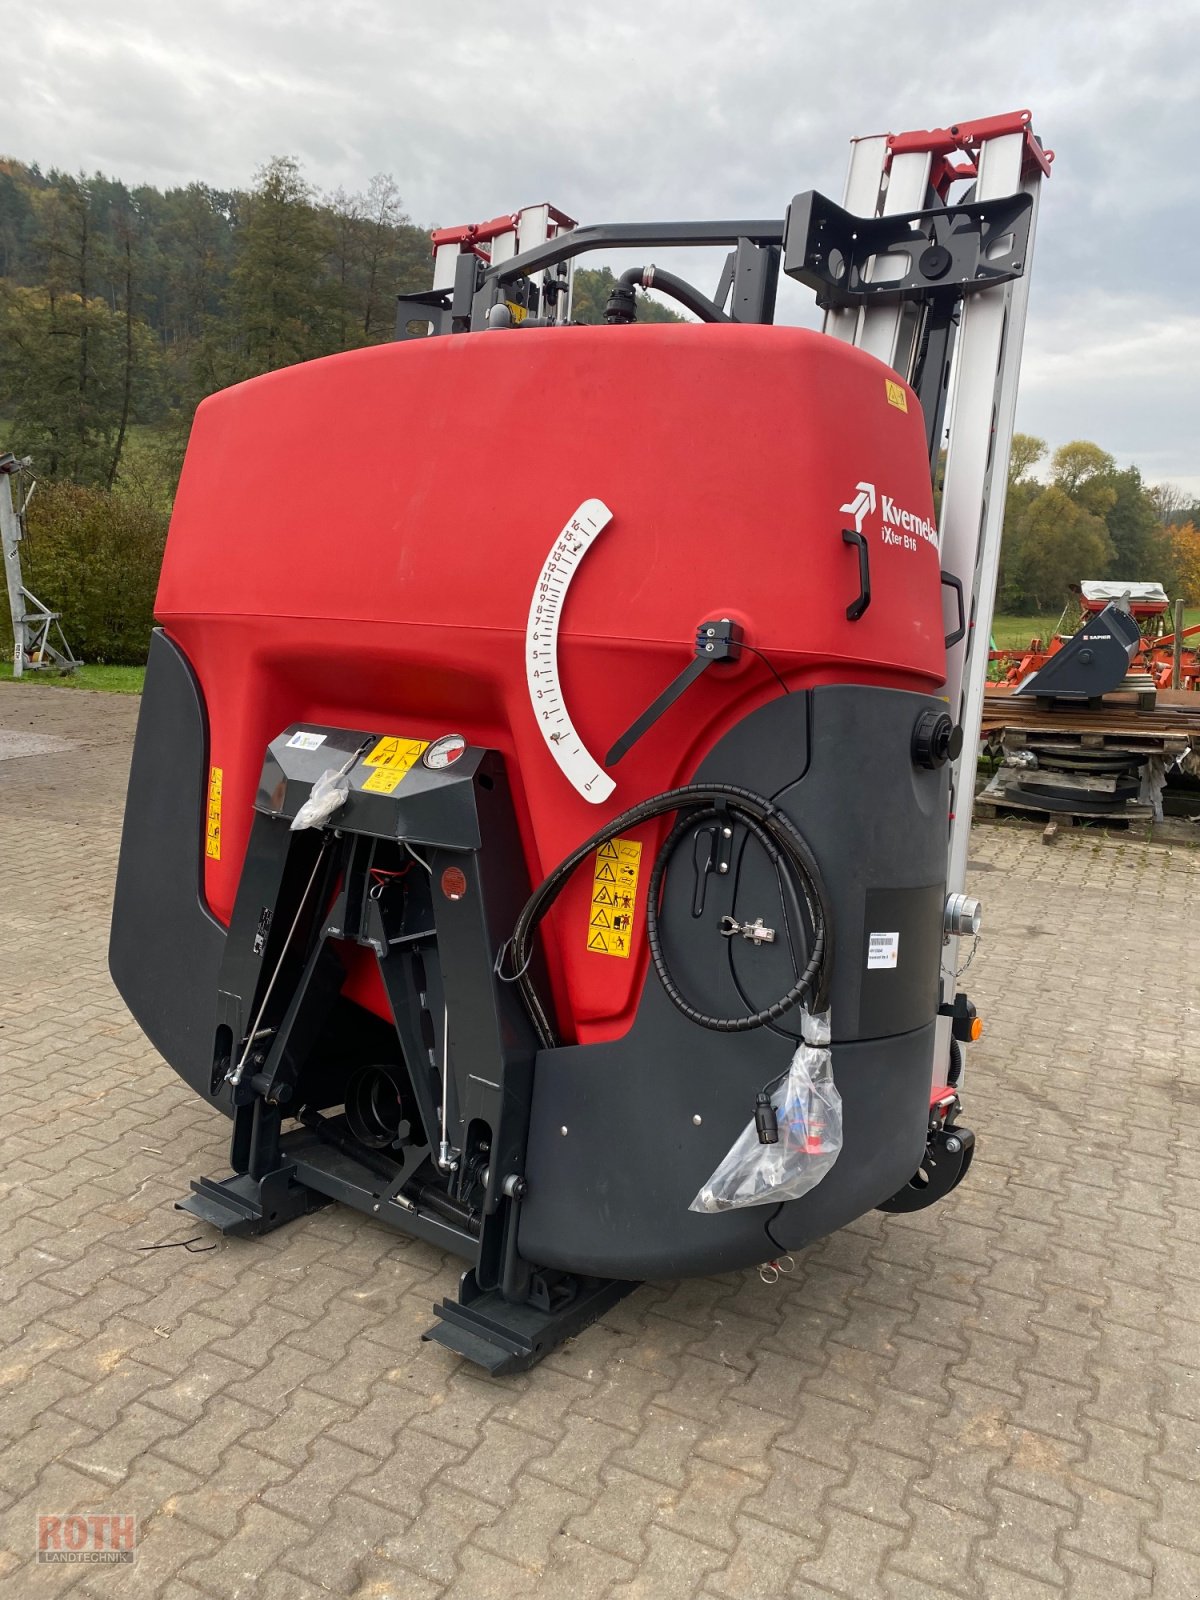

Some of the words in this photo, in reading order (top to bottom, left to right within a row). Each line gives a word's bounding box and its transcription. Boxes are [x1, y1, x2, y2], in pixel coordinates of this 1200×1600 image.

[571, 519, 580, 531] 16
[564, 530, 572, 541] 15
[881, 525, 902, 546] iXter
[903, 534, 917, 551] B16
[557, 541, 566, 552] 14
[552, 551, 562, 562] 13
[548, 562, 557, 573] 12
[543, 572, 551, 582] 11
[539, 582, 549, 592] 10
[539, 594, 546, 603] 9
[536, 605, 543, 614] 8
[535, 616, 541, 626] 7
[532, 632, 539, 640] 6
[532, 650, 539, 660] 5
[533, 670, 540, 678] 4
[536, 690, 544, 699] 3
[542, 711, 550, 720] 2
[584, 783, 592, 791] 0
